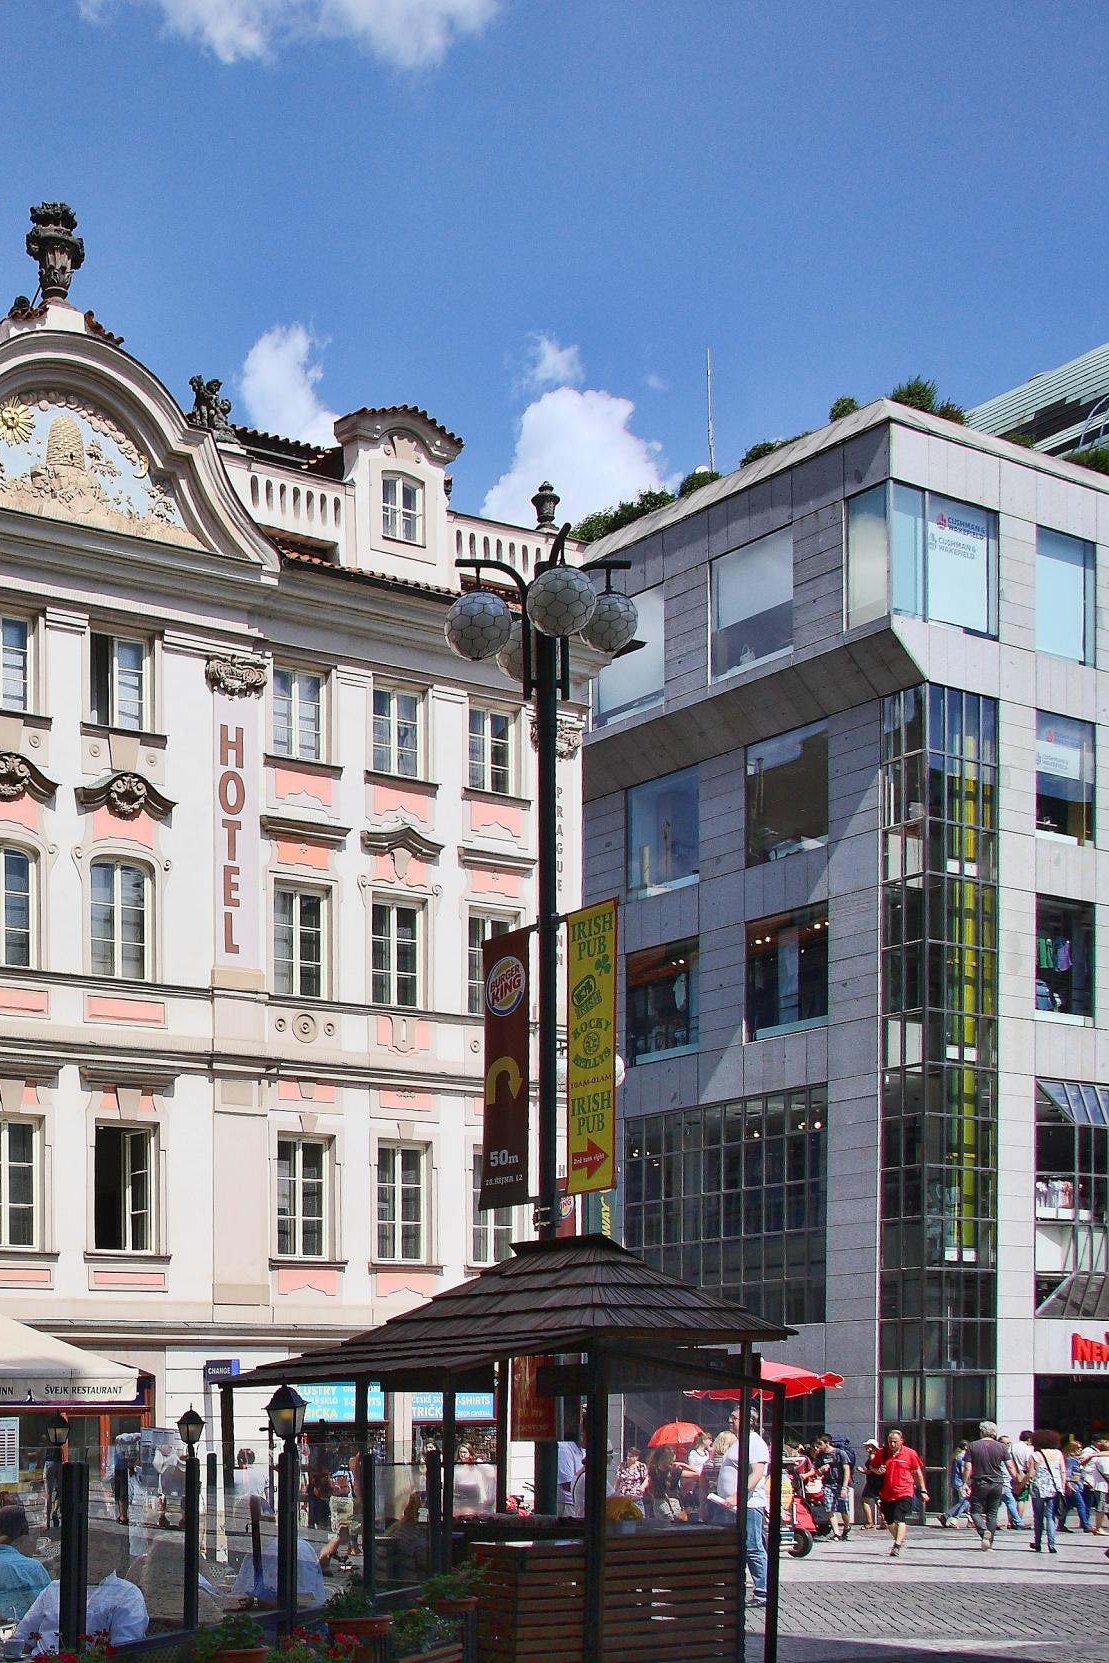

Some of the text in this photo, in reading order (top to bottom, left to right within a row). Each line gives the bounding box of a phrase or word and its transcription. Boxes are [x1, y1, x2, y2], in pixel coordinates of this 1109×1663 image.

[948, 516, 981, 531] CUSHMAN
[938, 537, 971, 551] CUSHMAN
[218, 723, 246, 955] HOTEL
[556, 786, 564, 892] PRAGUE
[571, 911, 614, 942] IRISH
[577, 935, 606, 960] PUB
[490, 963, 520, 991] BURGER
[491, 974, 521, 1006] KING
[572, 1017, 612, 1040] ROCKY
[571, 1090, 612, 1116] IRISH
[577, 1112, 605, 1136] PUB
[489, 1149, 519, 1167] 50m
[207, 1367, 231, 1375] CHANGE
[44, 1385, 123, 1395] ŠVEJK RESTAURANT
[412, 1404, 443, 1418] TRIČK
